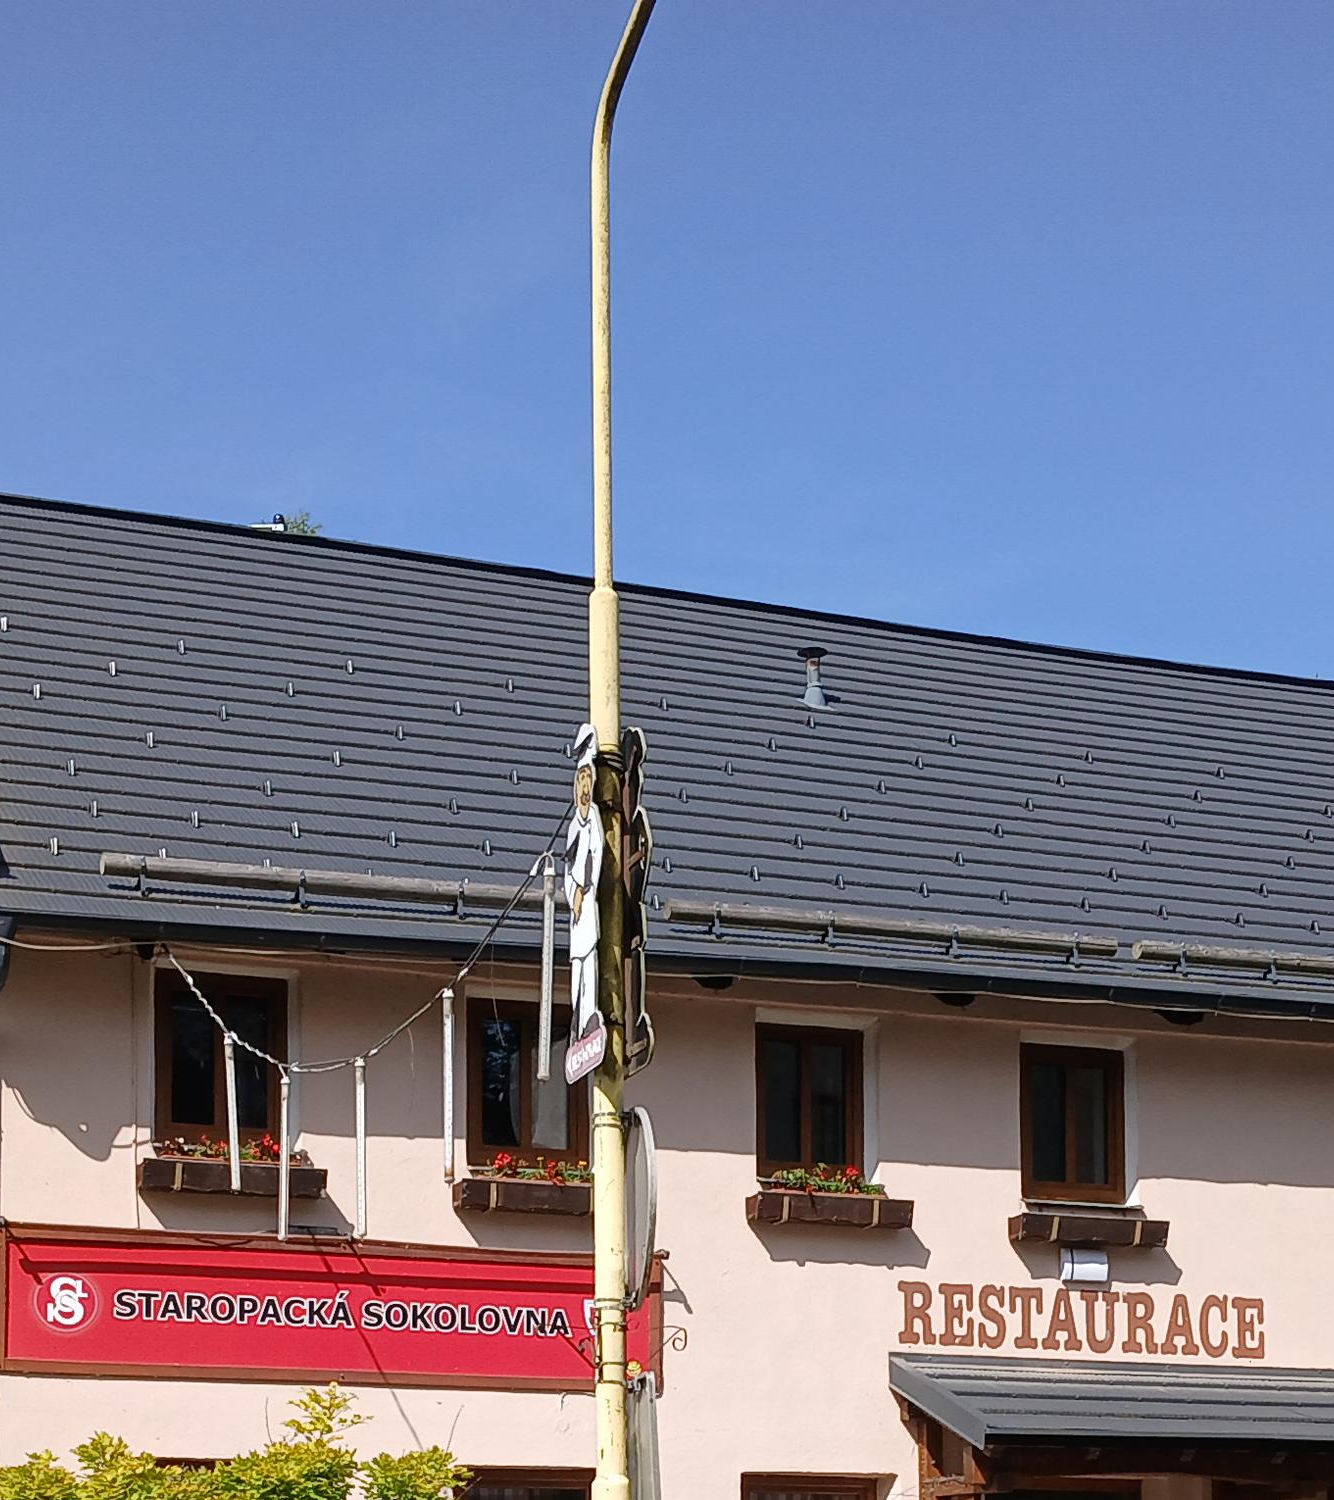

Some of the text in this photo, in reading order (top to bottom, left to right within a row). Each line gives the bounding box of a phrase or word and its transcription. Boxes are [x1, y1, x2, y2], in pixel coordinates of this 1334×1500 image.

[113, 1290, 353, 1328] STAROPACKÁ
[361, 1300, 572, 1337] SOKOLOVNA
[898, 1280, 1266, 1359] RESTAURACE
